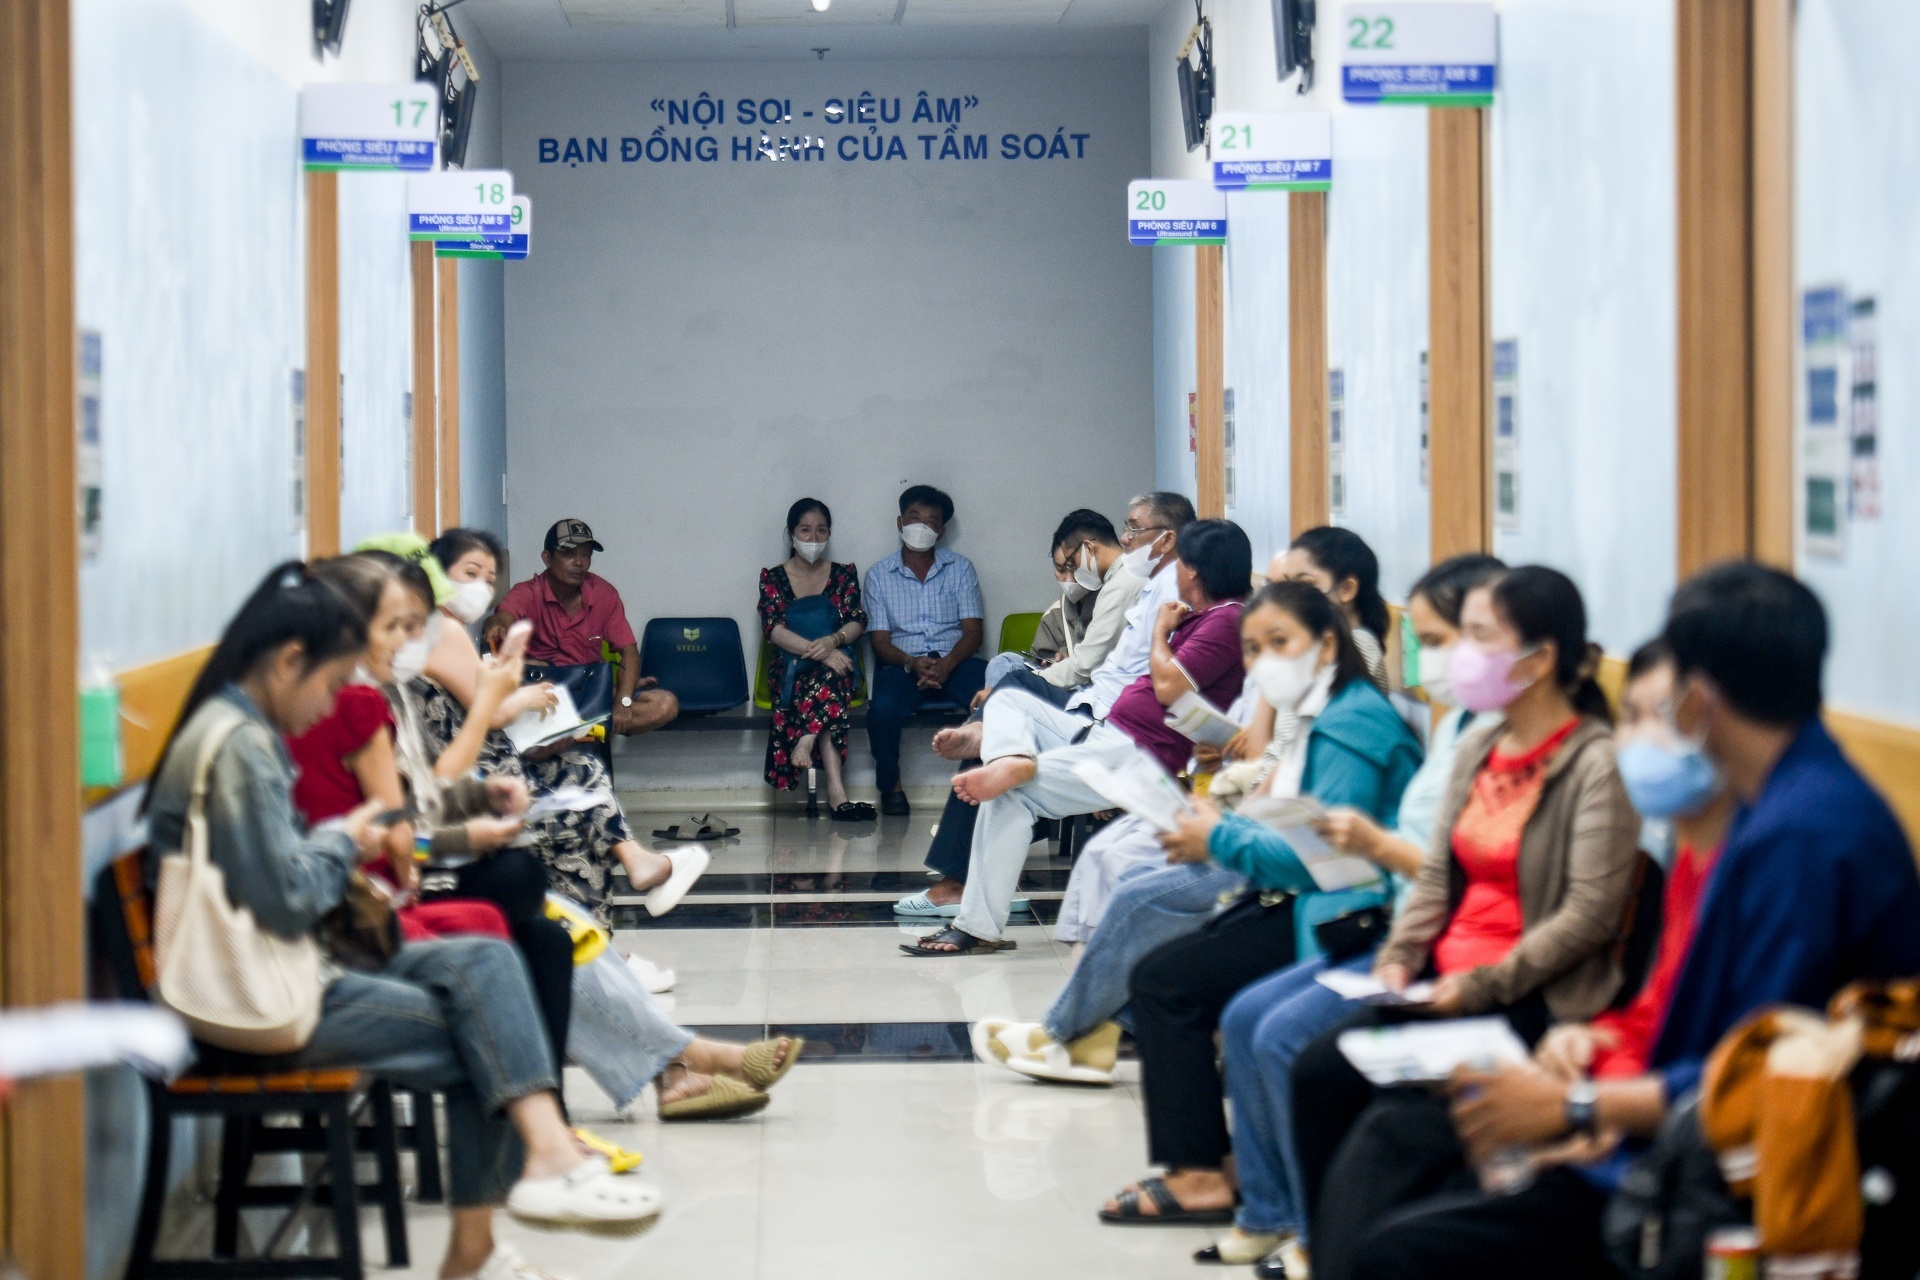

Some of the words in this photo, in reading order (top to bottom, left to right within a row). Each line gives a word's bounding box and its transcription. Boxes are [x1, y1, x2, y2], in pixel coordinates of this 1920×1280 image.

[1348, 17, 1394, 49] 22
[389, 100, 429, 127] 17
[824, 91, 900, 124] SIÊU
[538, 138, 608, 168] BẠN
[620, 125, 718, 162] ĐỒNG
[731, 129, 825, 162] HÀNH
[837, 126, 908, 161] CỦA
[917, 124, 988, 160] TẦM
[1001, 126, 1090, 159] SOÁT
[1220, 125, 1251, 149] 21
[1222, 162, 1263, 174] PHÒNG
[1265, 161, 1292, 174] SIÊU
[1293, 160, 1312, 173] ÂM
[1313, 161, 1320, 173] 7
[474, 183, 504, 204] 18
[1136, 190, 1166, 211] 20
[419, 214, 454, 225] PHÒNG
[456, 214, 478, 225] SIÊU
[480, 214, 496, 226] ÂM
[496, 216, 503, 226] 5
[439, 225, 476, 233] Ultrasound
[1138, 220, 1171, 231] PHÒNG
[1172, 220, 1193, 231] SIÊU
[1195, 220, 1209, 231] ÂM
[1210, 222, 1217, 231] 6
[470, 243, 494, 251] Storage
[676, 644, 708, 652] STELLA
